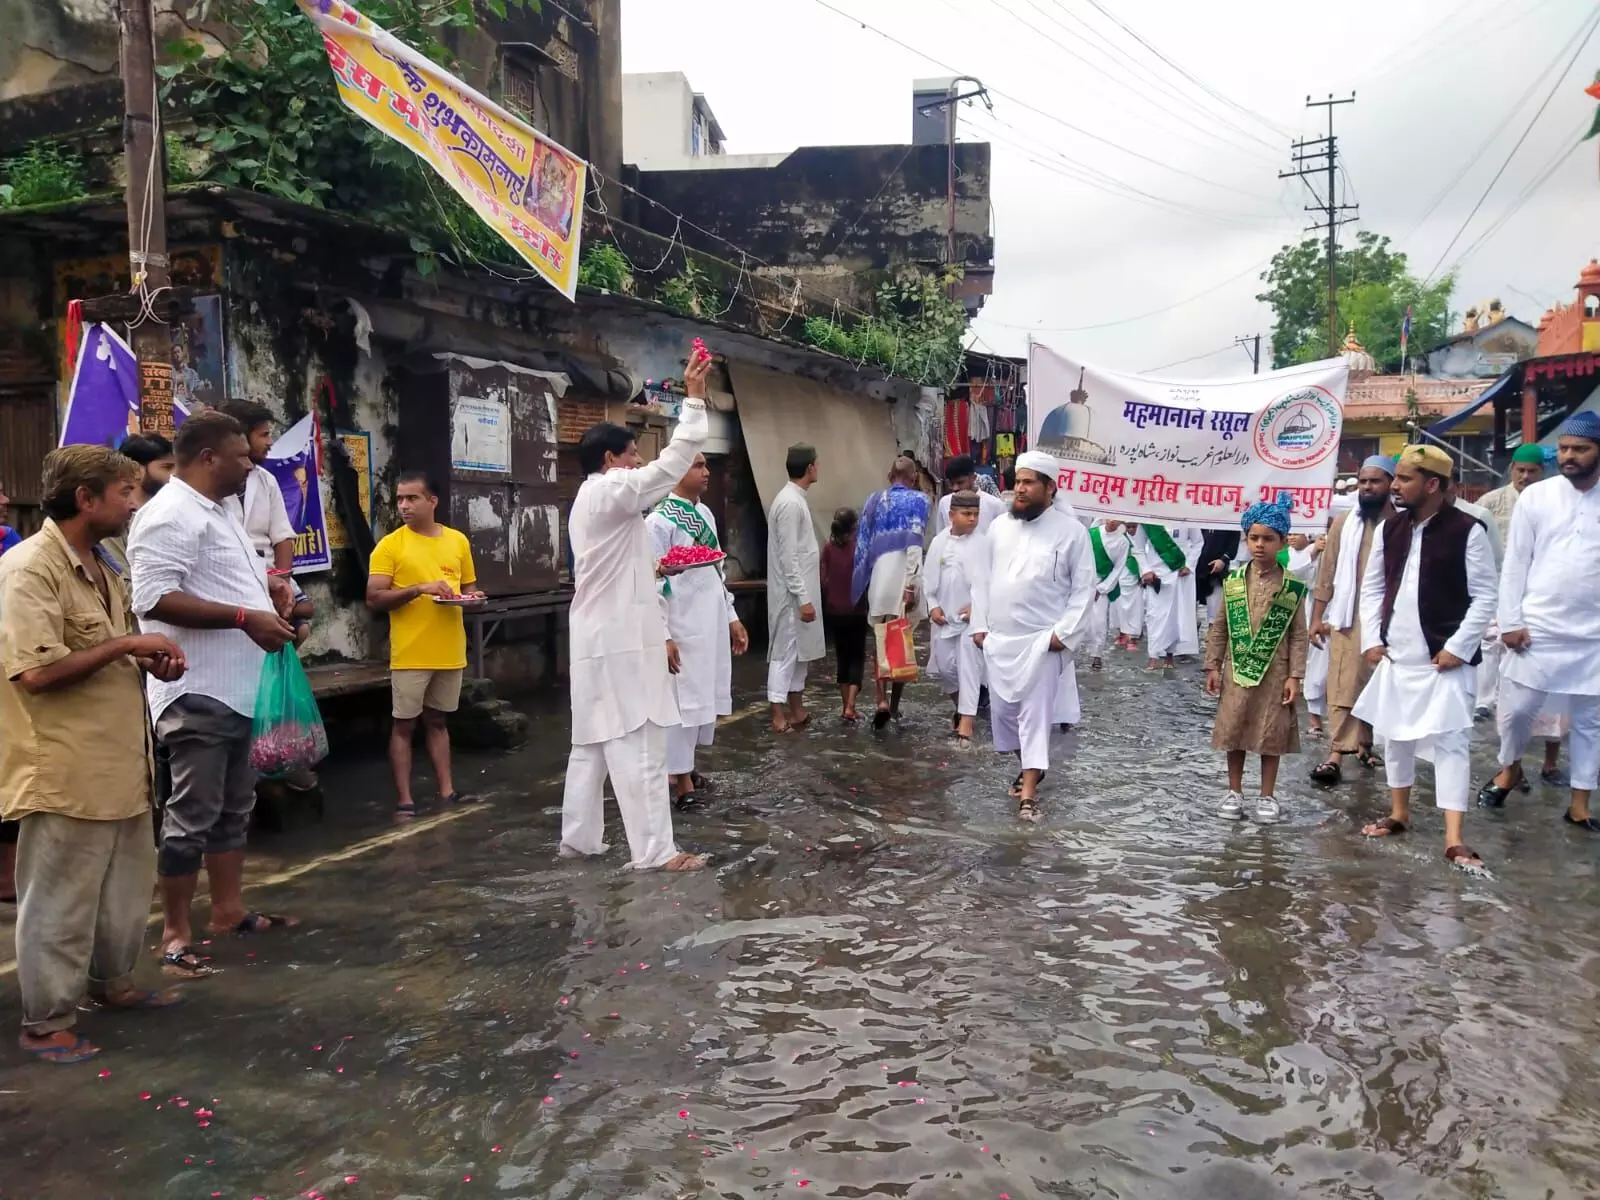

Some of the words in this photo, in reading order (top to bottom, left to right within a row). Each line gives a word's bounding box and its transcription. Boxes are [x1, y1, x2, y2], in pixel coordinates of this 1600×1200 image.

[1210, 410, 1254, 440] रसूल
[1080, 471, 1127, 504] उलूम
[1131, 475, 1182, 507] ग़रीब
